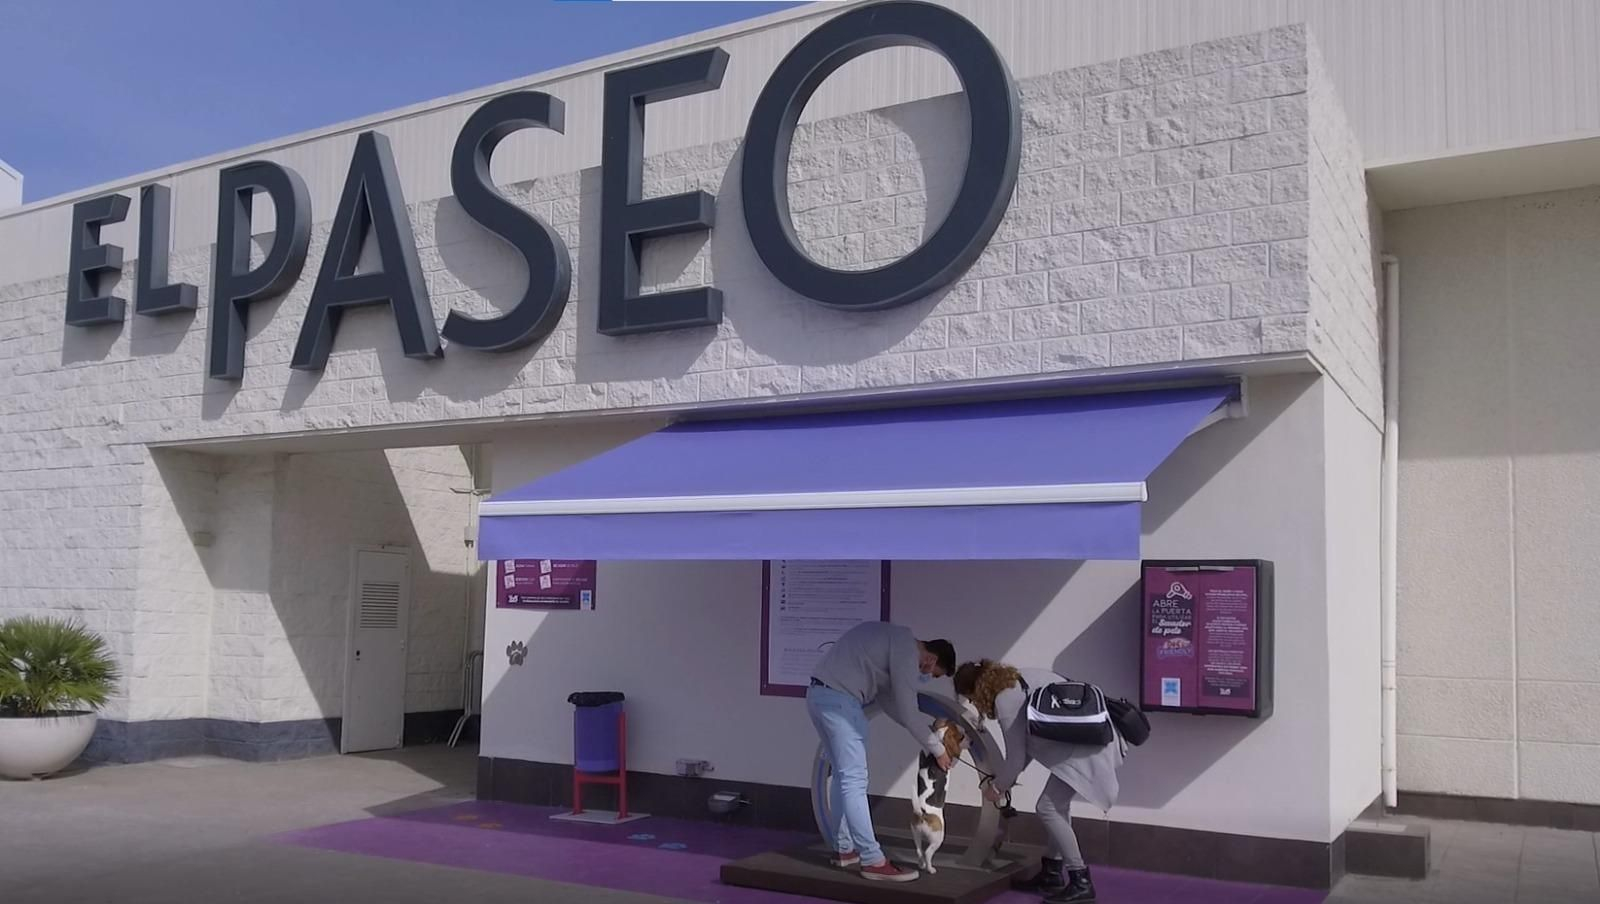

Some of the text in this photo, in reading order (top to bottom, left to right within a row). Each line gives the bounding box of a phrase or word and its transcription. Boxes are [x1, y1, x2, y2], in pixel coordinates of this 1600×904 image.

[66, 0, 1021, 380] EL PASEO
[1153, 599, 1180, 607] ABRE
